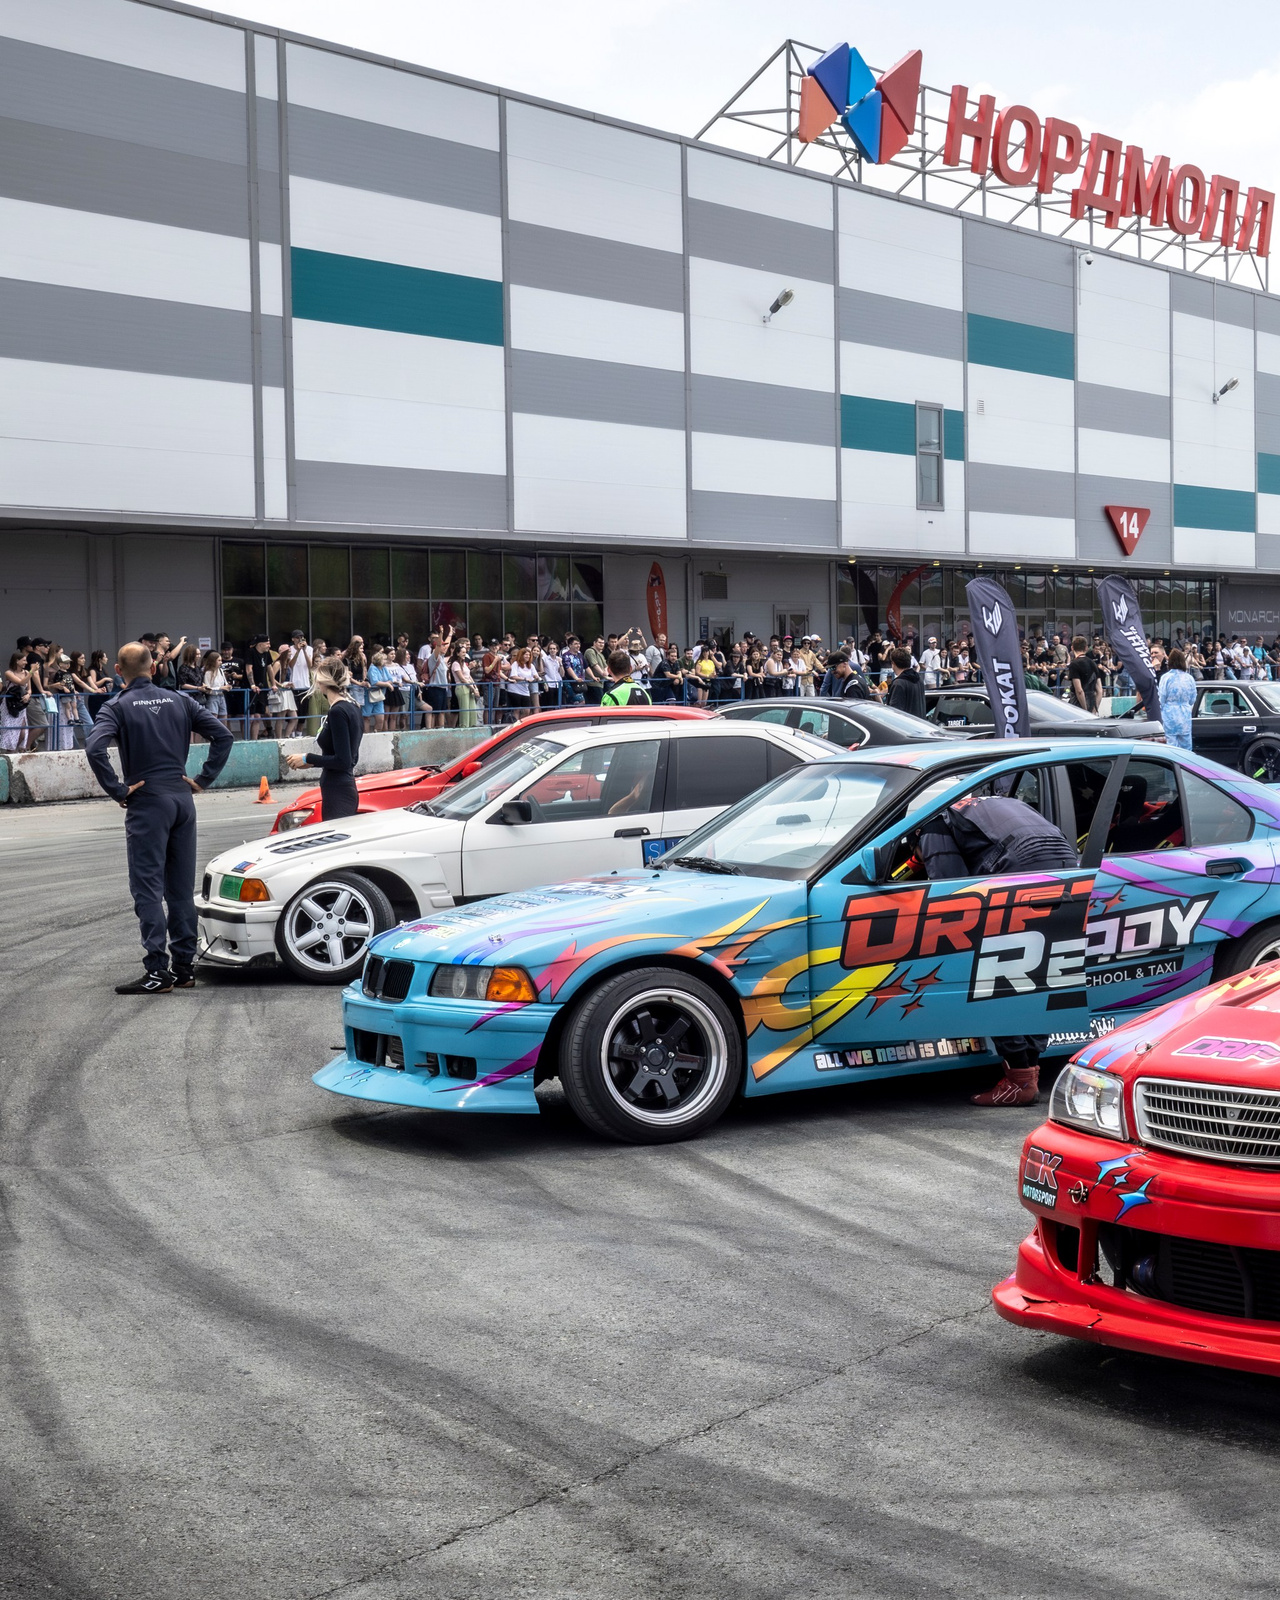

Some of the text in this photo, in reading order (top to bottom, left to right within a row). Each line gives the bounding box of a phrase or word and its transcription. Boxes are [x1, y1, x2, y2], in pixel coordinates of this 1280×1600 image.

[943, 84, 1276, 258] НОРДМОЛЛ
[1120, 511, 1139, 539] 14
[1228, 610, 1280, 623] MONARCH
[132, 697, 174, 707] FINNTRAIL
[992, 657, 1020, 738] РОКАТ
[1148, 961, 1177, 976] TAXI
[877, 1042, 917, 1062] need
[919, 1042, 936, 1058] is
[1024, 1147, 1062, 1190] DK
[1022, 1184, 1056, 1207] MOTORSPORT
